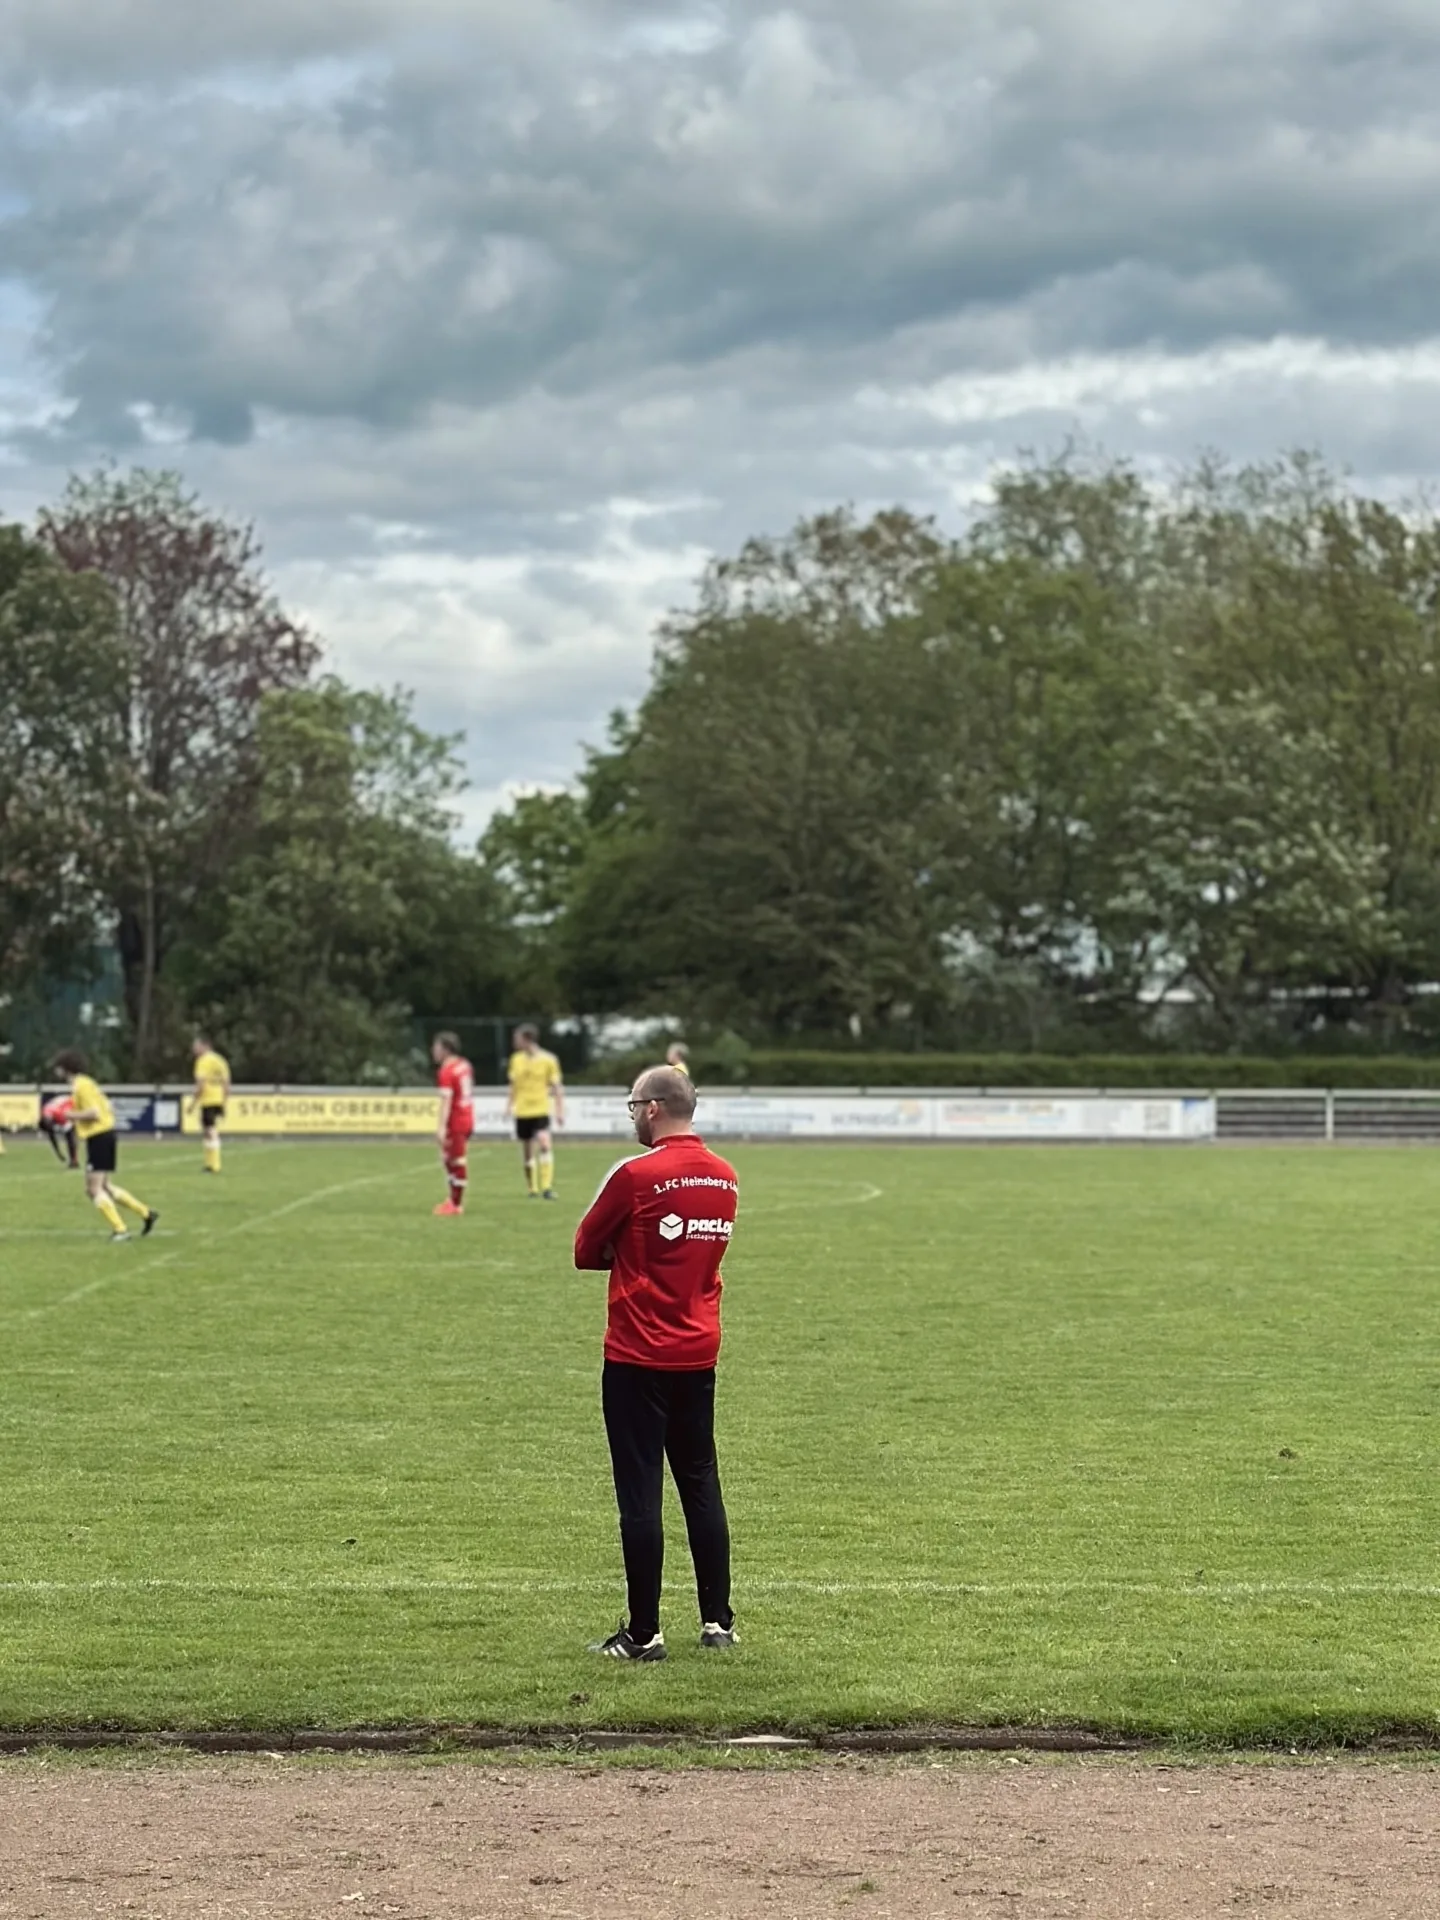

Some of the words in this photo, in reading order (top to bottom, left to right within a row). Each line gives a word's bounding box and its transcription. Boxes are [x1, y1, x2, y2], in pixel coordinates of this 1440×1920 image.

[239, 1100, 325, 1116] STADION
[331, 1100, 438, 1117] OBERBRUC
[653, 1178, 680, 1194] 1.FC
